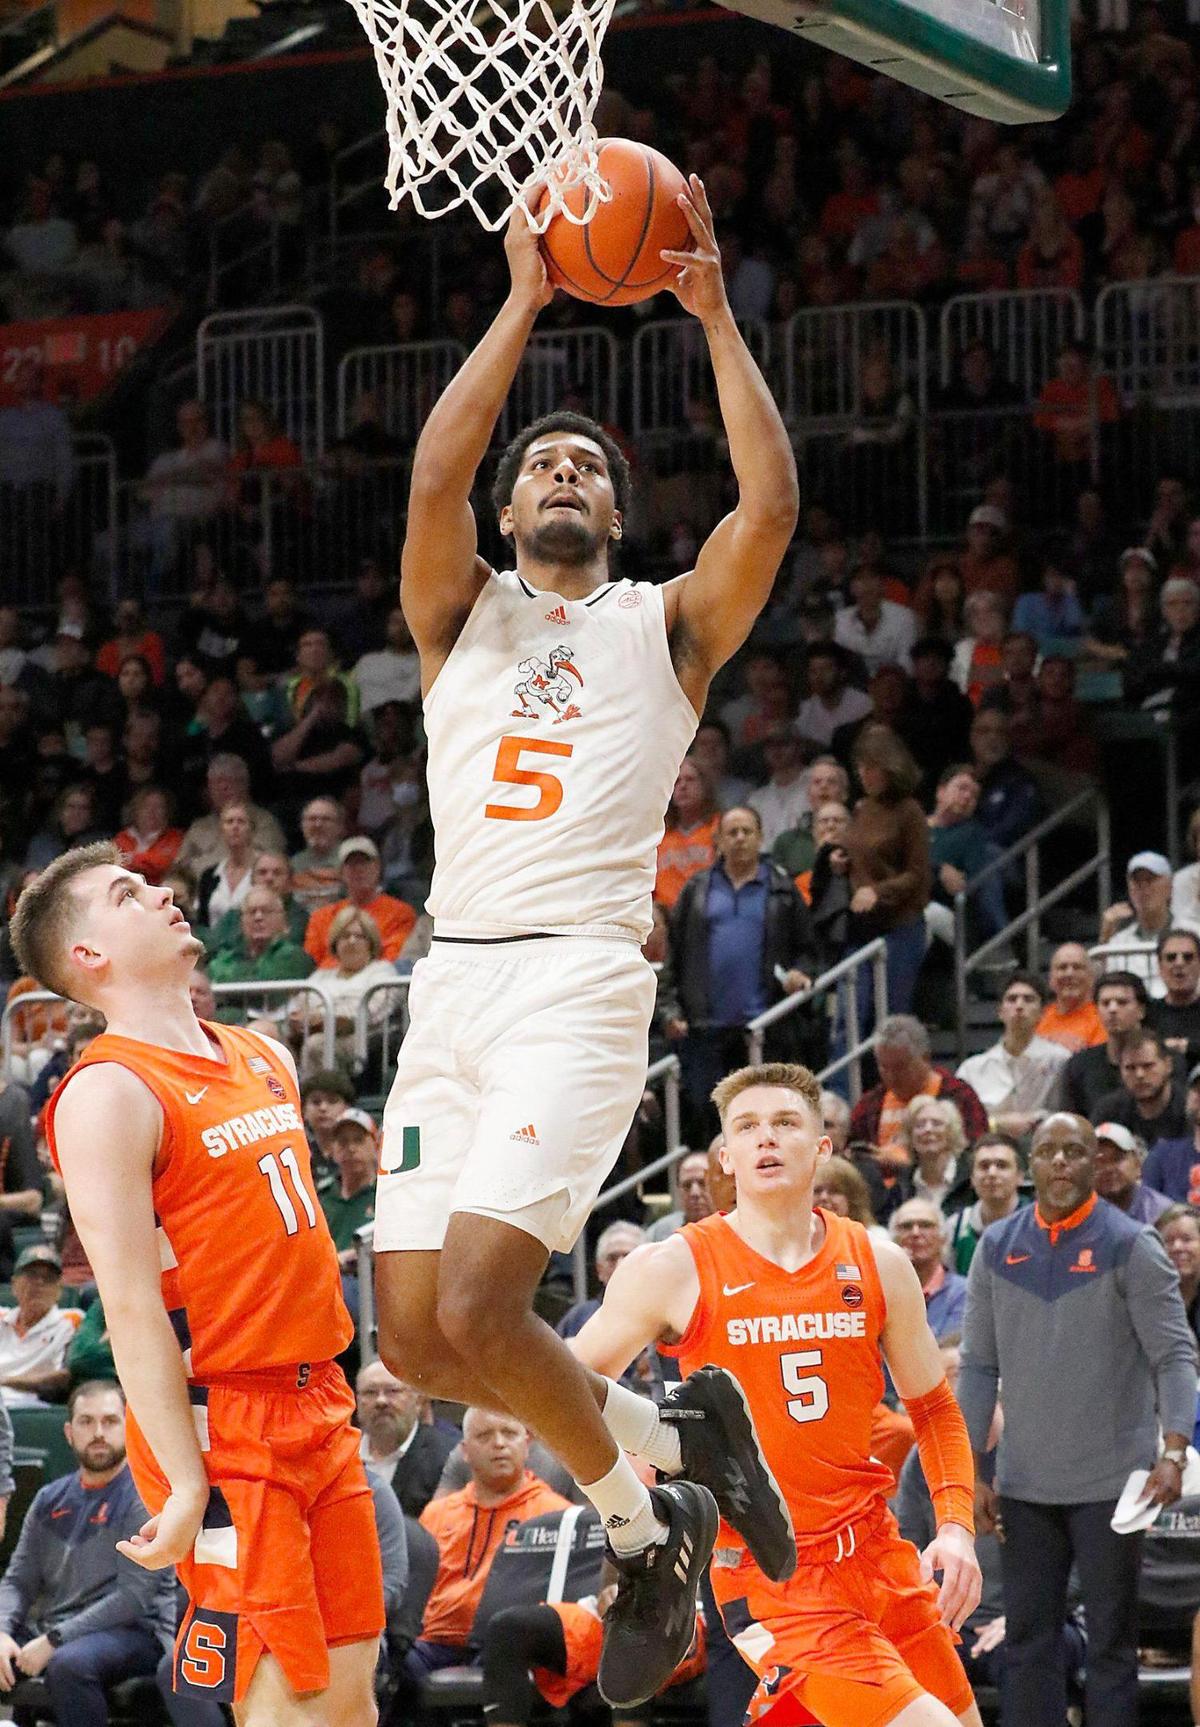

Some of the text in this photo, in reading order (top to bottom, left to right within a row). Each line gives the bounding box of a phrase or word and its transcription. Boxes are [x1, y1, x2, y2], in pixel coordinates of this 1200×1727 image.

[544, 613, 571, 625] adidas
[532, 674, 551, 690] M
[484, 736, 574, 822] 5
[200, 1103, 304, 1159] SYRACUSE
[509, 1133, 541, 1147] adidas
[258, 1147, 316, 1236] 11
[726, 1311, 867, 1346] SYRACUSE
[295, 1361, 312, 1390] S
[779, 1349, 830, 1424] 5
[181, 1619, 227, 1690] S
